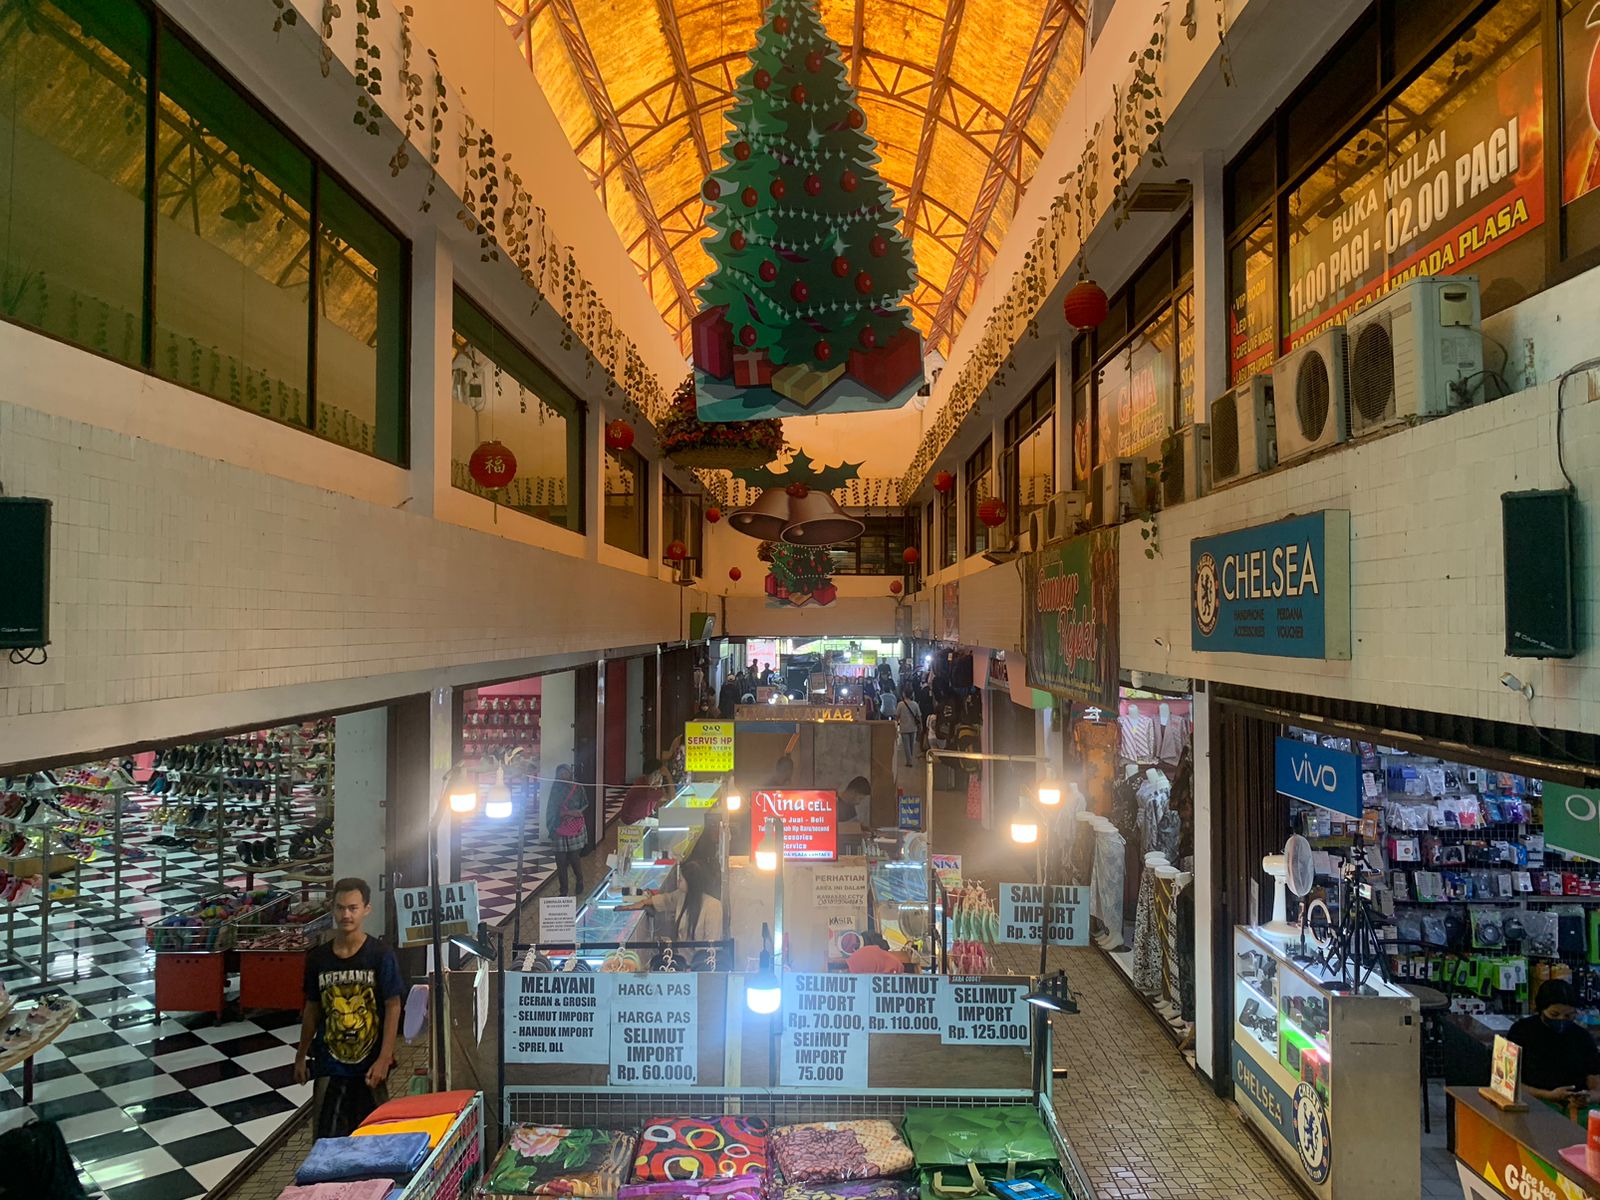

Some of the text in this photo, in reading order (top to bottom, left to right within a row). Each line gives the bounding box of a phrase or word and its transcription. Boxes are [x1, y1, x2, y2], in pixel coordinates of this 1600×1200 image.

[1333, 130, 1446, 243] BUKA MULAI
[1289, 262, 1327, 321] 11.00
[1330, 228, 1370, 294] PAGI
[1385, 170, 1449, 255] 02.00
[1456, 117, 1519, 209] PAGI
[1458, 198, 1529, 260] PLASA
[1235, 277, 1266, 310] VIP ROOM
[485, 455, 506, 474] 福
[1222, 540, 1319, 601] CHELSEA
[1038, 560, 1079, 613] Sumber
[1058, 605, 1098, 674] Rejeki
[687, 736, 732, 745] SERVIS HP
[1291, 752, 1337, 792] vivo
[756, 793, 832, 816] Nina CELL
[933, 860, 960, 869] NINA
[815, 874, 865, 882] PERHATIAN
[404, 886, 466, 909] OBAL
[829, 917, 853, 926] KASIR
[1014, 905, 1075, 924] IMPORT
[1006, 925, 1026, 940] Rp.
[319, 969, 375, 990] AREMANIA
[521, 976, 595, 994] MELAYANI
[795, 975, 858, 994] SELIMUT
[872, 976, 939, 995] SELIMUT
[618, 984, 691, 996] HARGA PAS
[954, 987, 1017, 1005] SELIMUT
[519, 996, 597, 1007] ECERAN & GROSIR
[798, 995, 856, 1013] IMPORT
[876, 996, 936, 1014] IMPORT
[518, 1010, 557, 1022] SELIMUT
[559, 1011, 595, 1022] IMPORT
[617, 1011, 691, 1023] HARGA PAS
[788, 1014, 811, 1030] Rp.
[958, 1006, 1013, 1022] IMPORT
[519, 1026, 557, 1037] HANDUK
[558, 1027, 594, 1038] IMPORT
[869, 1016, 888, 1031] Rp.
[949, 1024, 1027, 1040] Rp. 125.000
[624, 1027, 686, 1044] SELIMUT
[549, 1042, 564, 1053] DLL
[627, 1046, 684, 1062] IMPORT
[795, 1049, 847, 1064] IMPORT
[617, 1065, 639, 1081] Rp.
[798, 1066, 844, 1081] 75.000
[1236, 1060, 1282, 1125] CHELSEA
[1521, 1165, 1538, 1187] Ice
